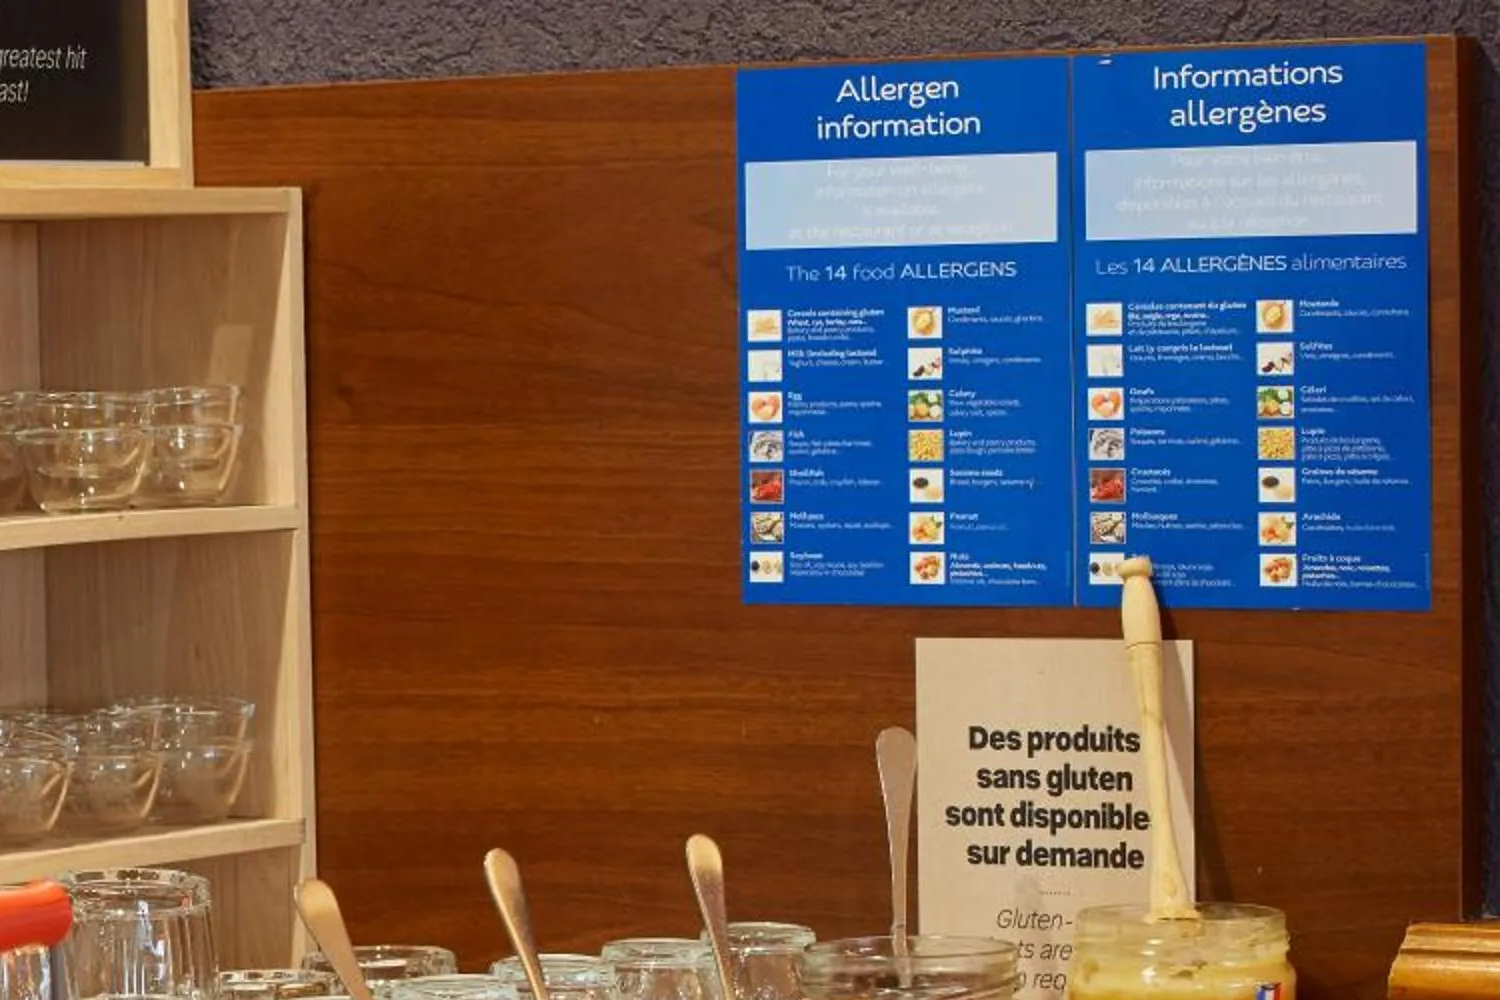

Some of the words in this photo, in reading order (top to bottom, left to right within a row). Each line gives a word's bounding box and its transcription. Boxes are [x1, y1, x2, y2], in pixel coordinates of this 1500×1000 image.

[65, 44, 88, 69] hit
[1153, 61, 1343, 90] Informations
[836, 75, 959, 108] Allergen
[817, 112, 981, 140] information
[1170, 99, 1327, 133] allergènes
[786, 266, 820, 282] The
[825, 265, 846, 280] 14
[853, 263, 895, 280] food
[900, 261, 1017, 279] ALLERGENS
[1096, 260, 1128, 275] Les
[1134, 258, 1155, 273] 14
[1160, 253, 1287, 273] ALLERGÈNES
[1292, 253, 1407, 271] alimentaires
[968, 725, 1022, 751] Des
[1027, 724, 1141, 759] produits
[976, 767, 1042, 790] sans
[1045, 763, 1134, 797] gluten
[945, 803, 1005, 827] sont
[1009, 800, 1151, 836] disponible
[966, 844, 1010, 865] sur
[1015, 839, 1145, 869] demande
[996, 907, 1073, 929] Gluten-
[1039, 943, 1073, 961] are
